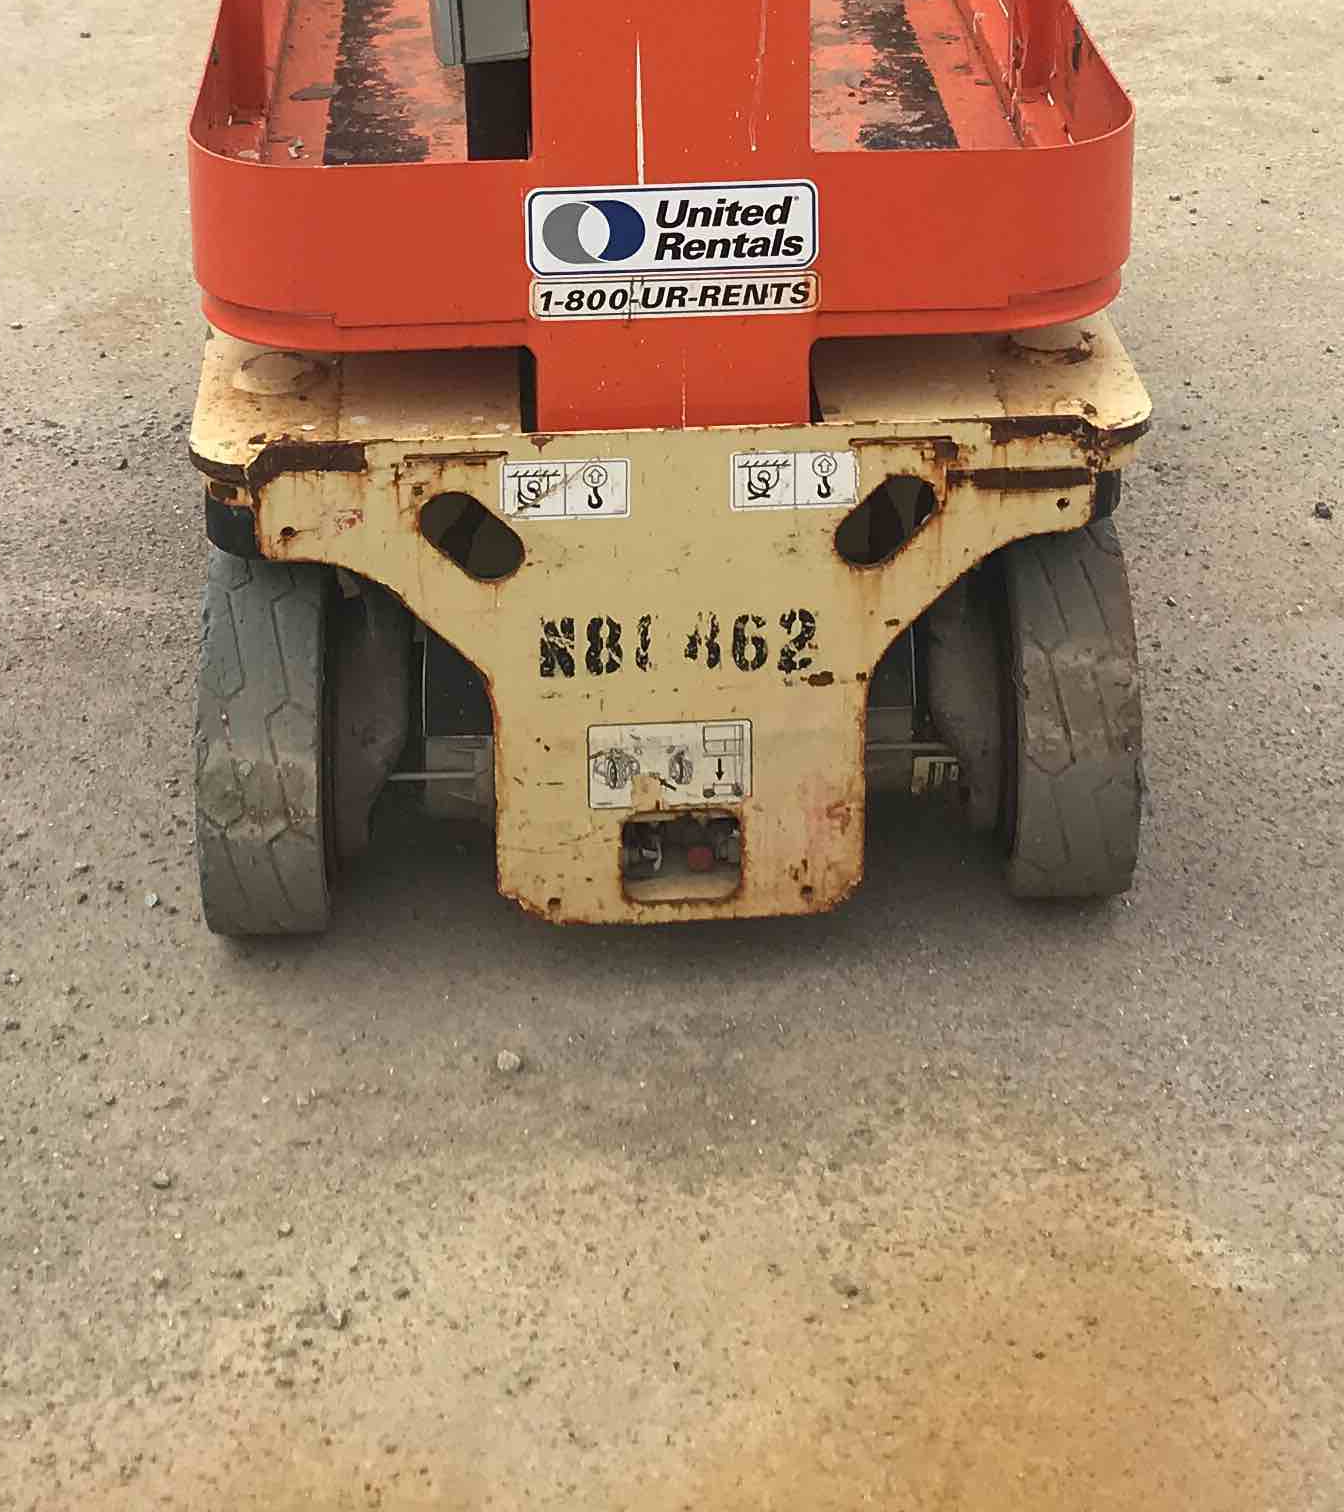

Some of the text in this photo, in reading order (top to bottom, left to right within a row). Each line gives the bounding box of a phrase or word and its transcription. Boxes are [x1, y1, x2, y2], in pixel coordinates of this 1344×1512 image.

[655, 196, 792, 228] United
[654, 229, 803, 261] Rentals
[538, 281, 811, 312] 1-800-UR-RENTS
